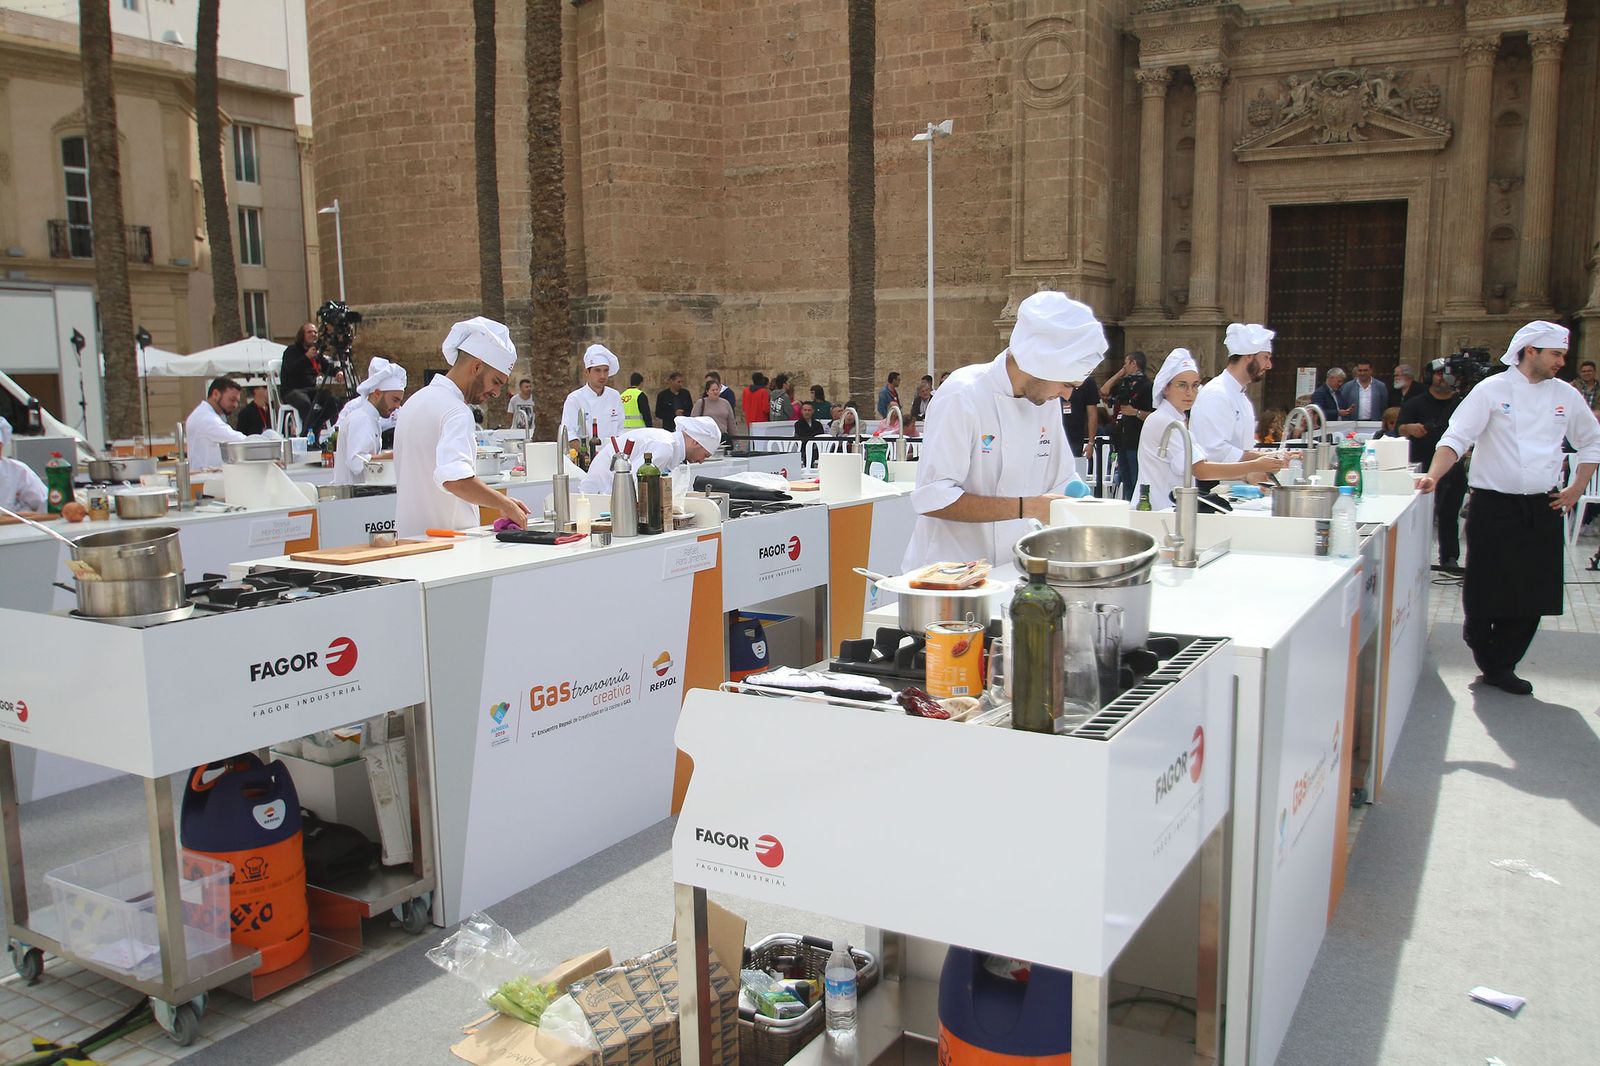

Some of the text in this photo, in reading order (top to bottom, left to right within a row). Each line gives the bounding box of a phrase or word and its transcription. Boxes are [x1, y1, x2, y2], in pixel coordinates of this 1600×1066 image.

[759, 543, 785, 559] FAGOR
[250, 651, 318, 682] FAGOR
[592, 684, 631, 706] creativa
[650, 676, 676, 692] REPSOL
[0, 700, 14, 712] GOR
[253, 684, 361, 718] FAGOR INDUSTRIAL
[1155, 751, 1188, 804] FAGOR
[695, 827, 749, 851] FAGOR
[696, 863, 787, 887] FAGOR INDUSTRIAL
